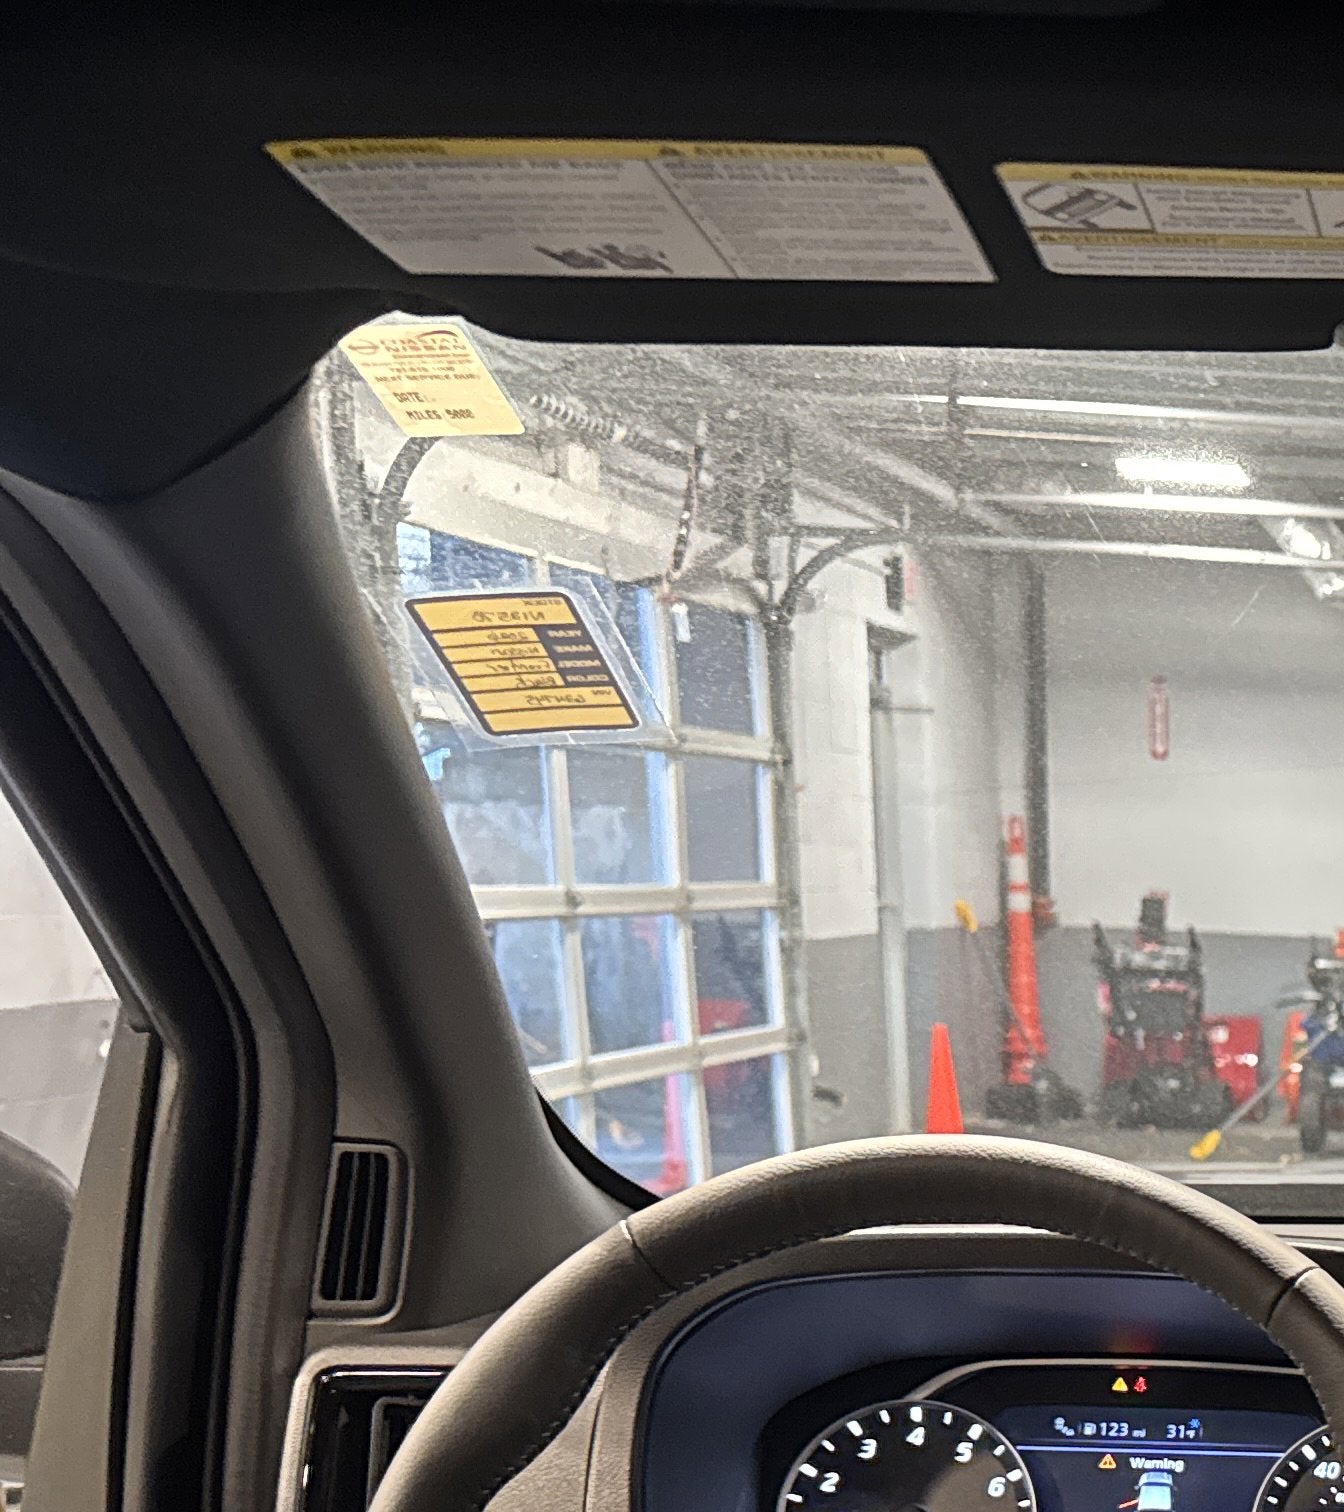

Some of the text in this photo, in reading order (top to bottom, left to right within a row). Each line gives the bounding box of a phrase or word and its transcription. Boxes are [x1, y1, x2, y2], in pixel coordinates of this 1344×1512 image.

[406, 410, 443, 420] MILES
[905, 1426, 926, 1447] 4
[1099, 1422, 1130, 1438] 123
[857, 1438, 878, 1460] 3
[954, 1441, 974, 1464] 5
[1129, 1456, 1185, 1473] Warning
[1313, 1461, 1342, 1480] 40
[819, 1472, 840, 1493] 2
[987, 1476, 1007, 1498] 6
